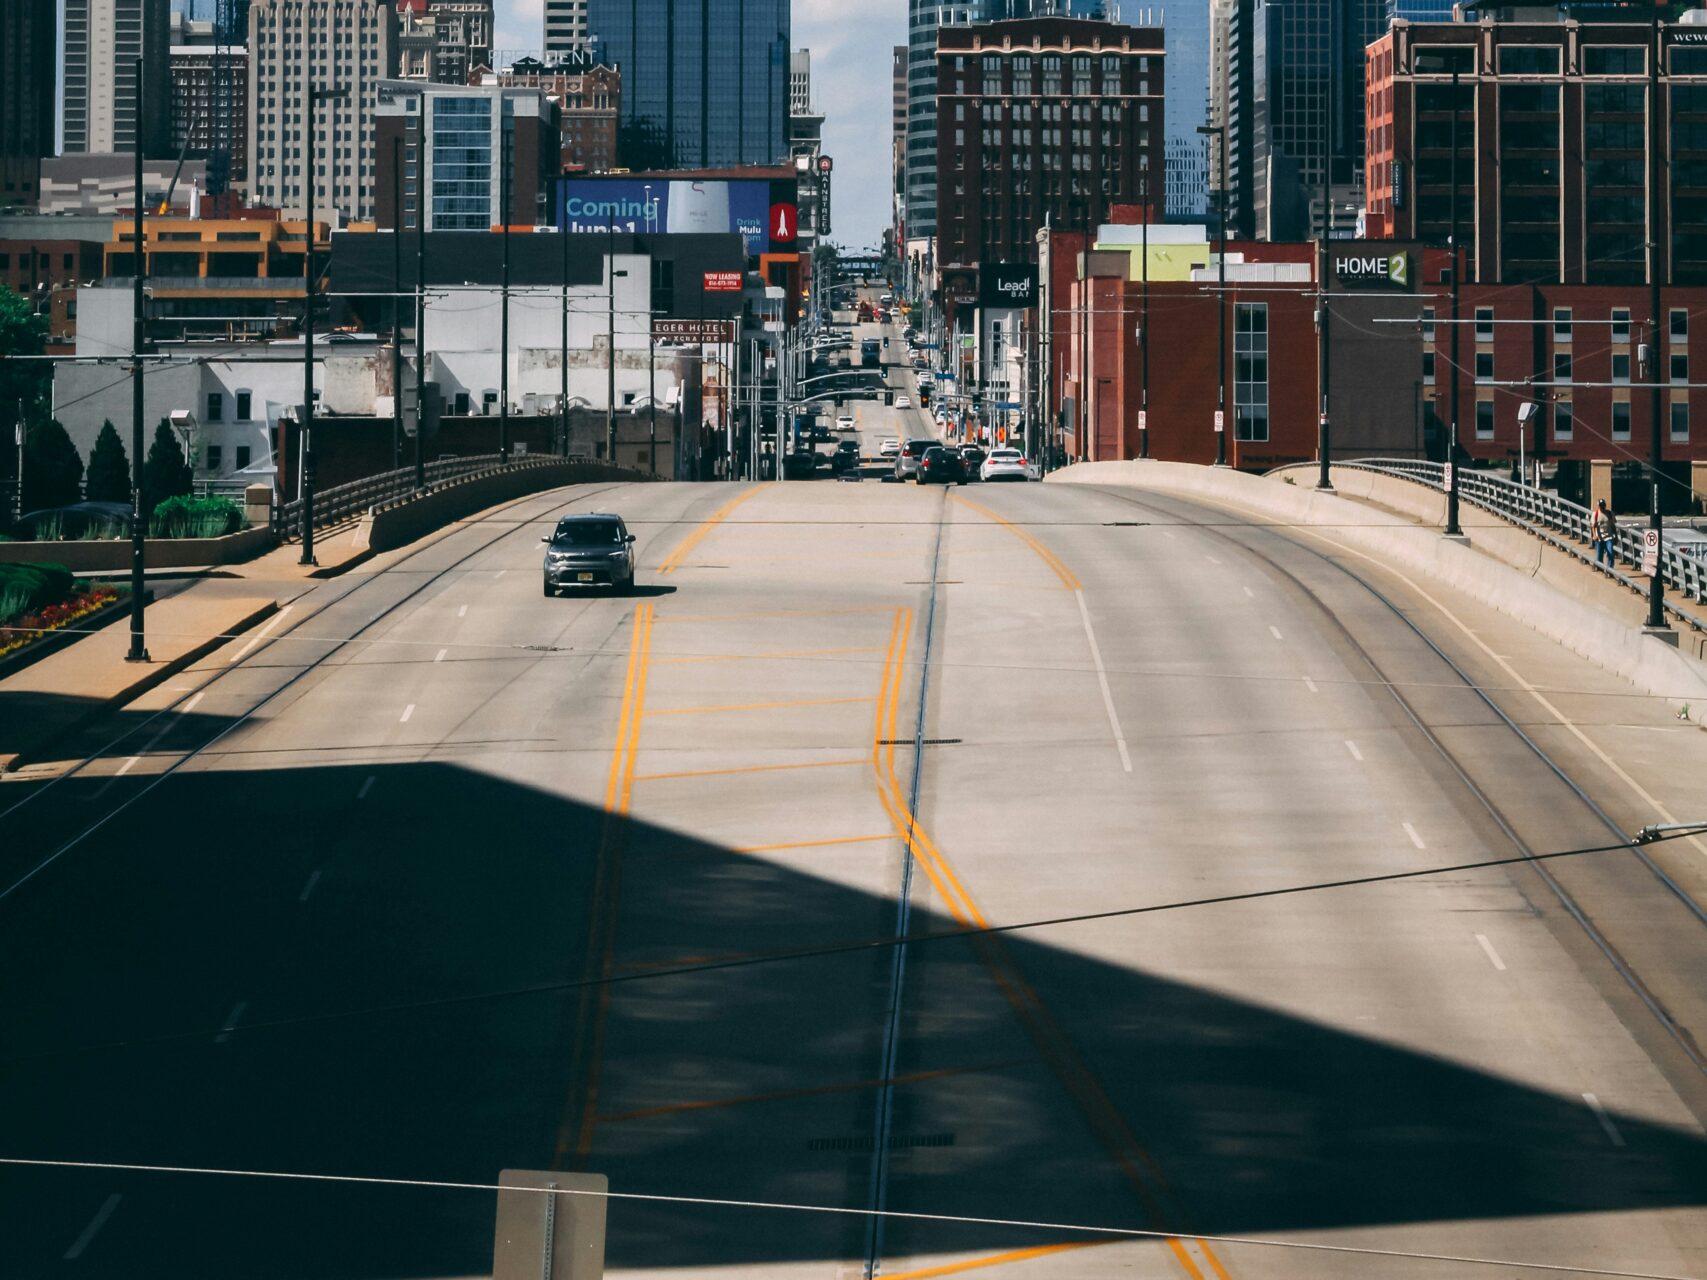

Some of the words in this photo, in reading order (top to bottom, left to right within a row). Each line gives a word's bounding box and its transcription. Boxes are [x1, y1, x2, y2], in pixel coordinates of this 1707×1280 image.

[488, 49, 597, 65] PRESIDENT
[566, 198, 657, 220] Coming
[736, 218, 761, 226] Drink
[739, 225, 761, 234] Mulu
[689, 324, 725, 332] HOTEL
